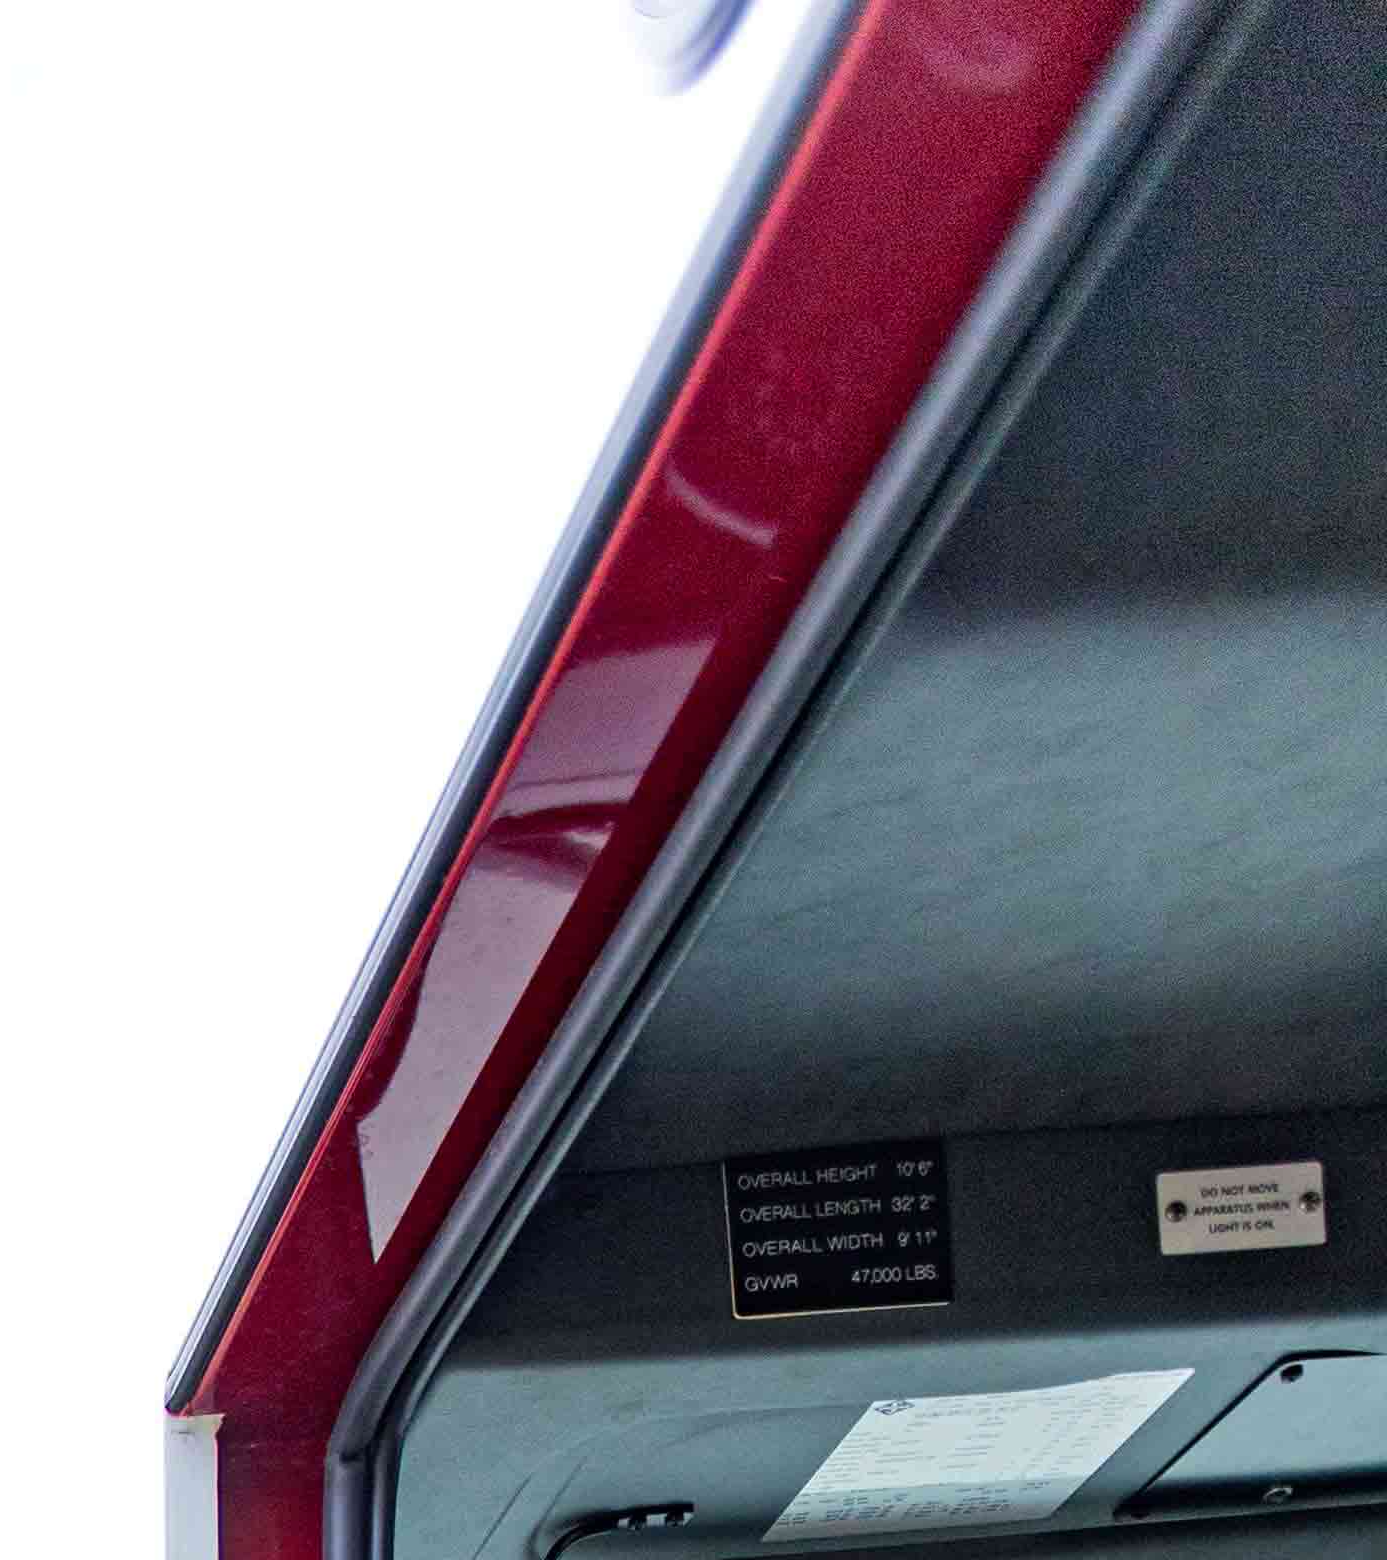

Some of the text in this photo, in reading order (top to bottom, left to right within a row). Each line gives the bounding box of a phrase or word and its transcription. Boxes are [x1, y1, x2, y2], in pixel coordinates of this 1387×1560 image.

[738, 1169, 812, 1190] OVERALL
[816, 1164, 877, 1183] HEIGHT
[1248, 1183, 1279, 1194] MOVE
[739, 1202, 812, 1223] OVERALL
[816, 1197, 881, 1217] LENGTH
[742, 1237, 822, 1258] OVERALL
[827, 1232, 884, 1251] WIDTH
[744, 1273, 800, 1292] GVWR
[851, 1266, 902, 1285] 47,000
